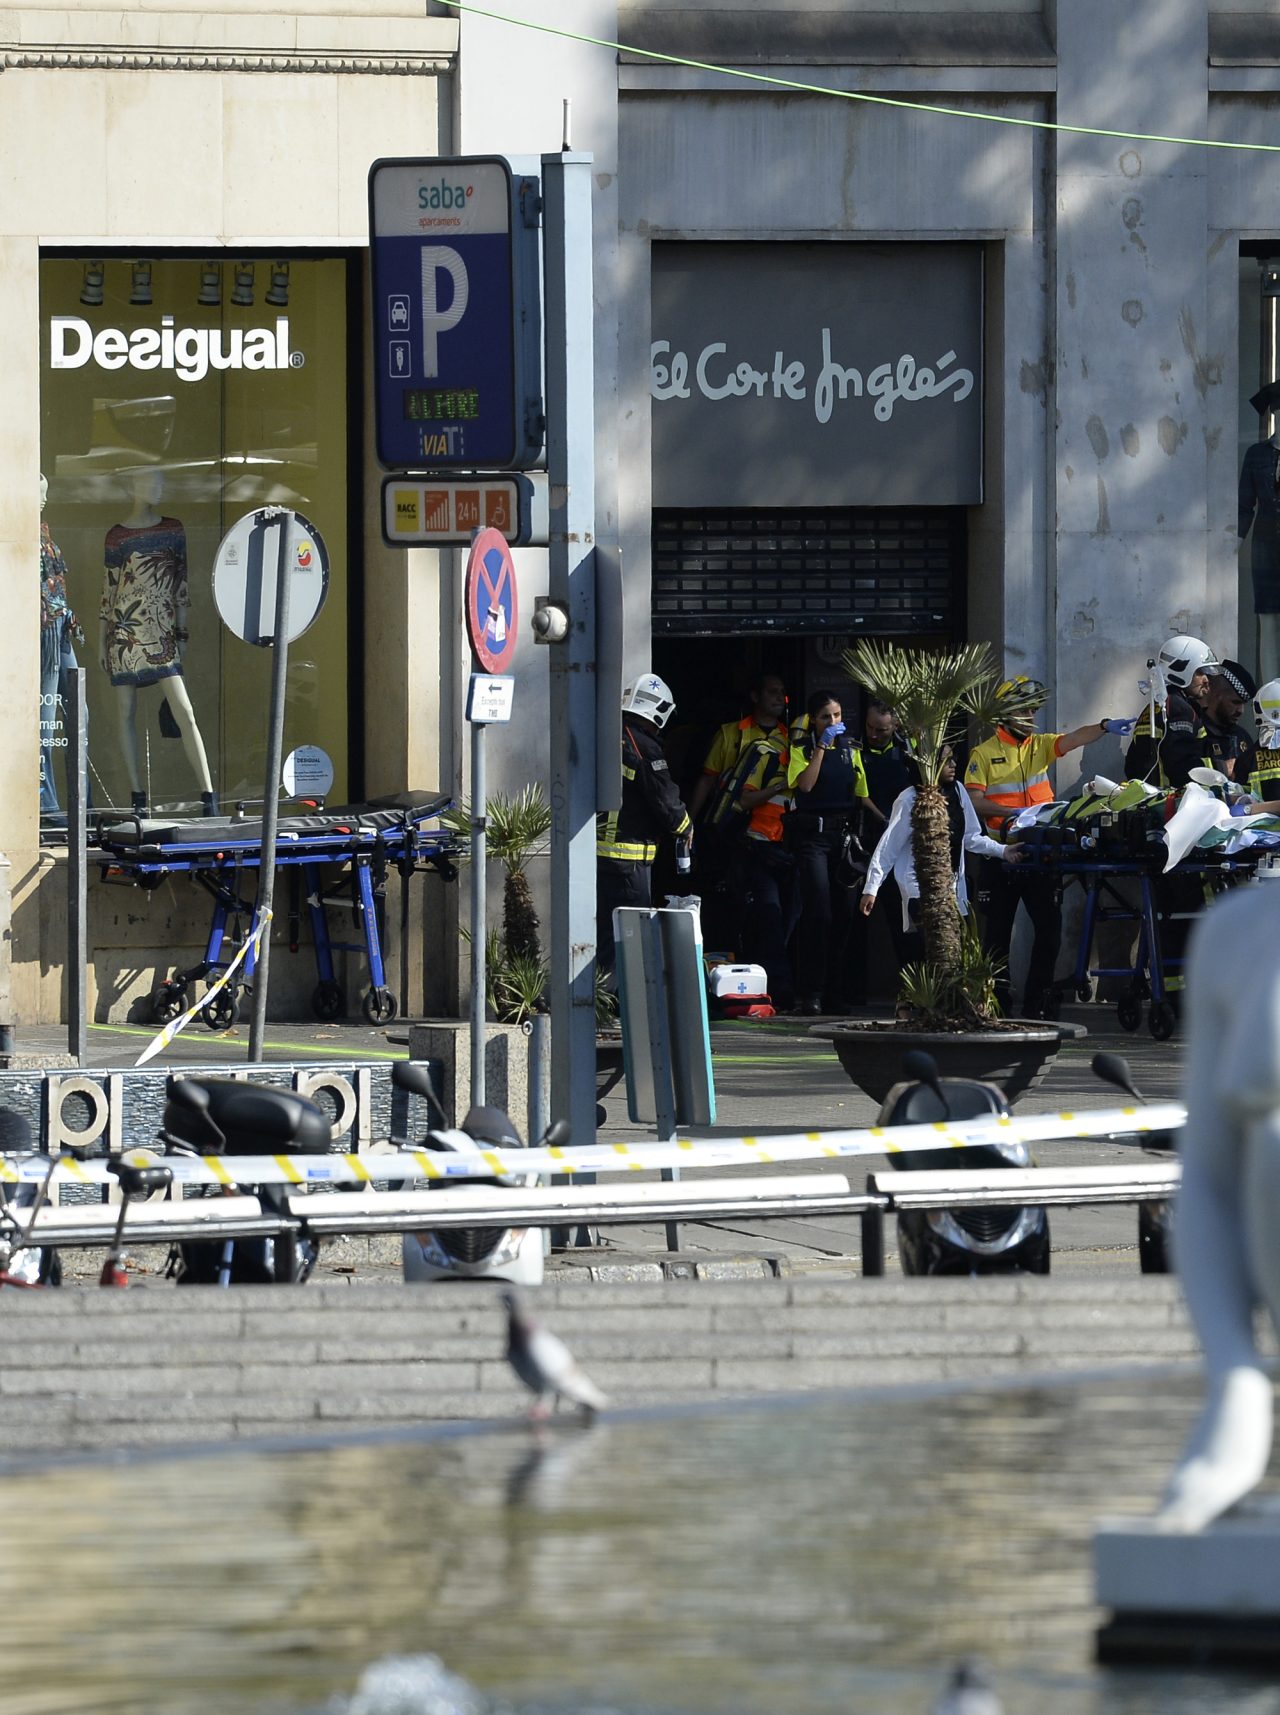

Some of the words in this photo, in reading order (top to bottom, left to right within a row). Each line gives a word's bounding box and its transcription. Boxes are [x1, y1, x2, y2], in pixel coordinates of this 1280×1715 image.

[418, 177, 465, 209] saba
[418, 217, 461, 228] aparcaments
[421, 245, 469, 378] P
[650, 340, 691, 401] El
[696, 342, 806, 401] Corte
[814, 327, 974, 424] Inglés
[397, 503, 416, 513] RACC
[458, 502, 469, 521] 24
[471, 502, 478, 521] h
